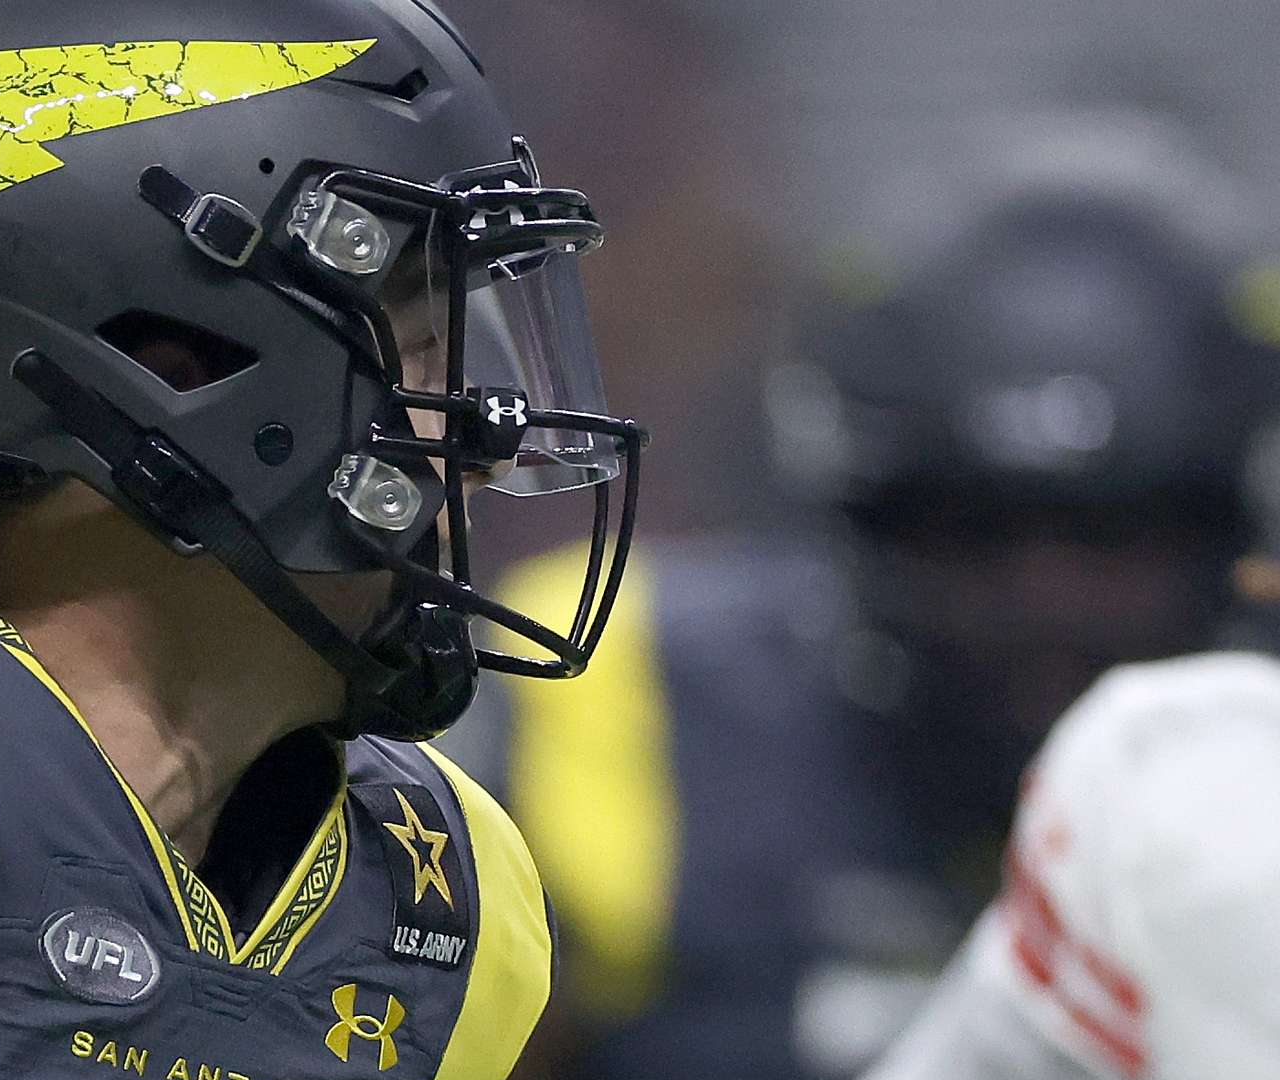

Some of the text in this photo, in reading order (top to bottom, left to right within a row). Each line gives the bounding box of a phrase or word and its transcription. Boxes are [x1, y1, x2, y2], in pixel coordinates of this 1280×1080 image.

[64, 929, 142, 982] UFL
[419, 930, 466, 965] ARMY
[71, 1030, 150, 1076] SAN
